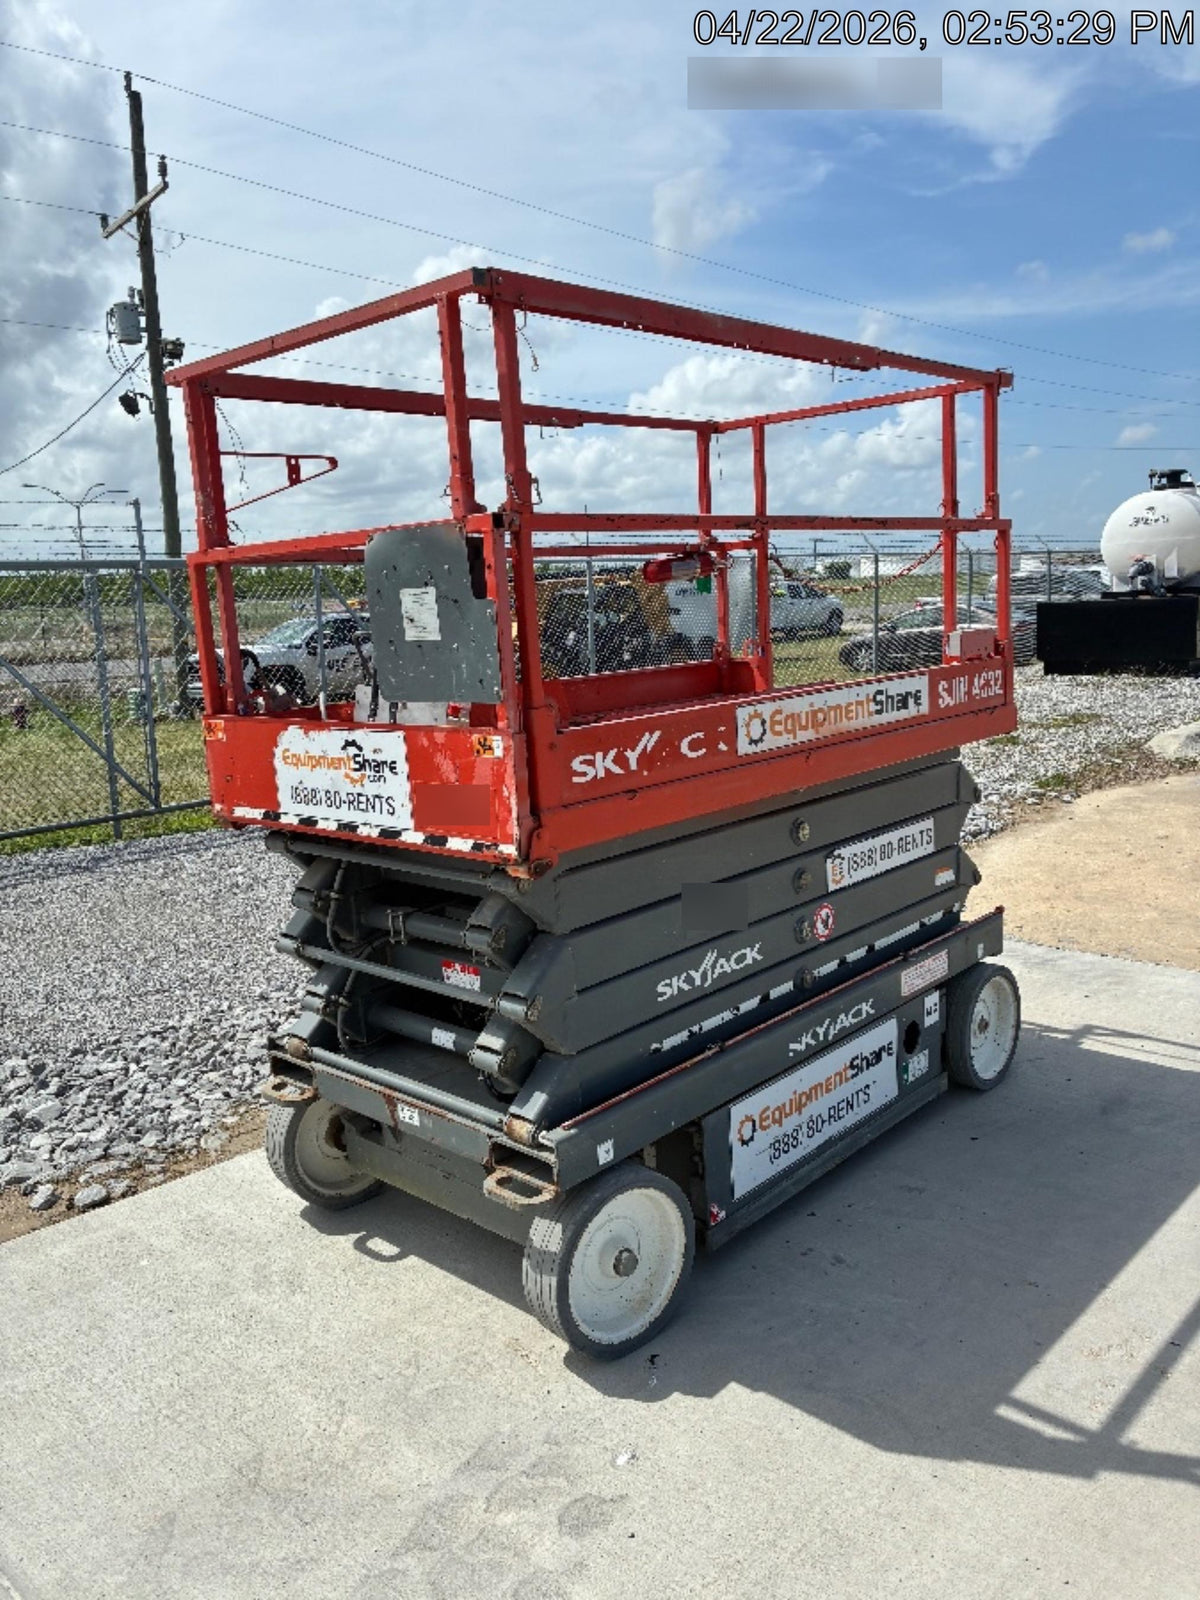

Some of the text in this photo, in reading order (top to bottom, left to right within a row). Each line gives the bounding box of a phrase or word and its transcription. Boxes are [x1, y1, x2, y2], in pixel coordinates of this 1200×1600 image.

[769, 689, 922, 737] EquipmentShare
[281, 748, 398, 775] EquipmentShare
[656, 942, 763, 1001] SKYJACK
[758, 1040, 894, 1132] EquipmentShare
